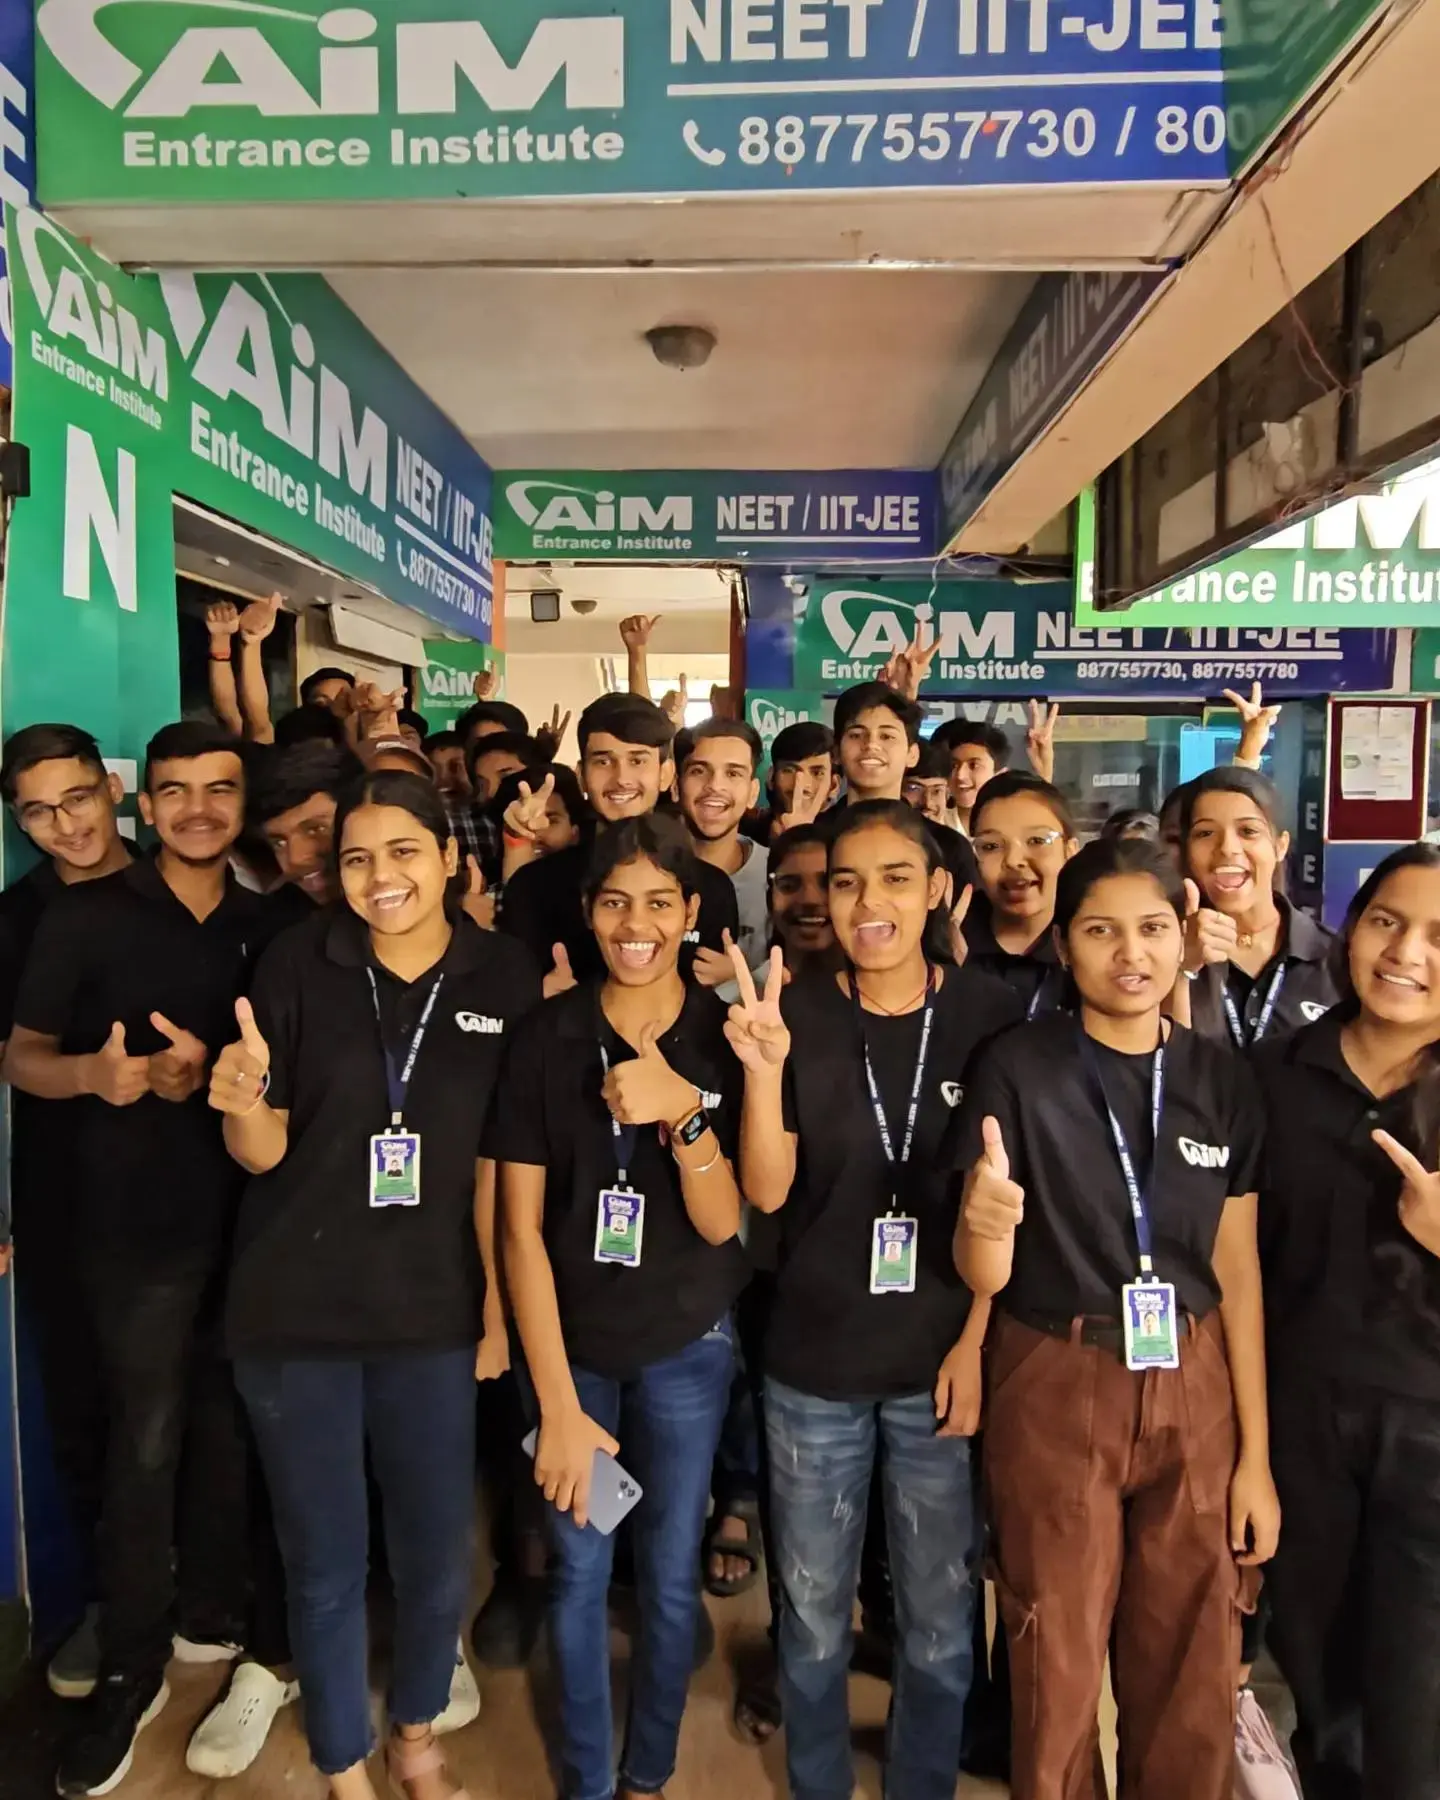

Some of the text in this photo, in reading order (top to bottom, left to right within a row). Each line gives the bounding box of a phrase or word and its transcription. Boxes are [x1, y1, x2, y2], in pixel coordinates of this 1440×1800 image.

[122, 8, 624, 117] AiM
[670, 0, 883, 63] NEET
[123, 126, 624, 167] Entrance Institute
[738, 108, 1096, 165] 8877557730
[48, 265, 169, 403] AiM
[31, 330, 163, 431] Entrance Institute
[191, 280, 388, 512] AiM
[190, 402, 386, 562] Entrance Institute
[396, 434, 444, 533] NEET
[533, 491, 692, 531] AiM
[717, 496, 794, 531] NEET
[820, 496, 919, 531] IIT-JEE
[533, 535, 692, 550] Entrance Institute
[408, 547, 475, 617] 8877557730
[848, 603, 965, 658] AiM
[1037, 611, 1143, 648] NEET
[941, 660, 1045, 679] Institute
[1077, 662, 1298, 681] 8877557730, 8877557780
